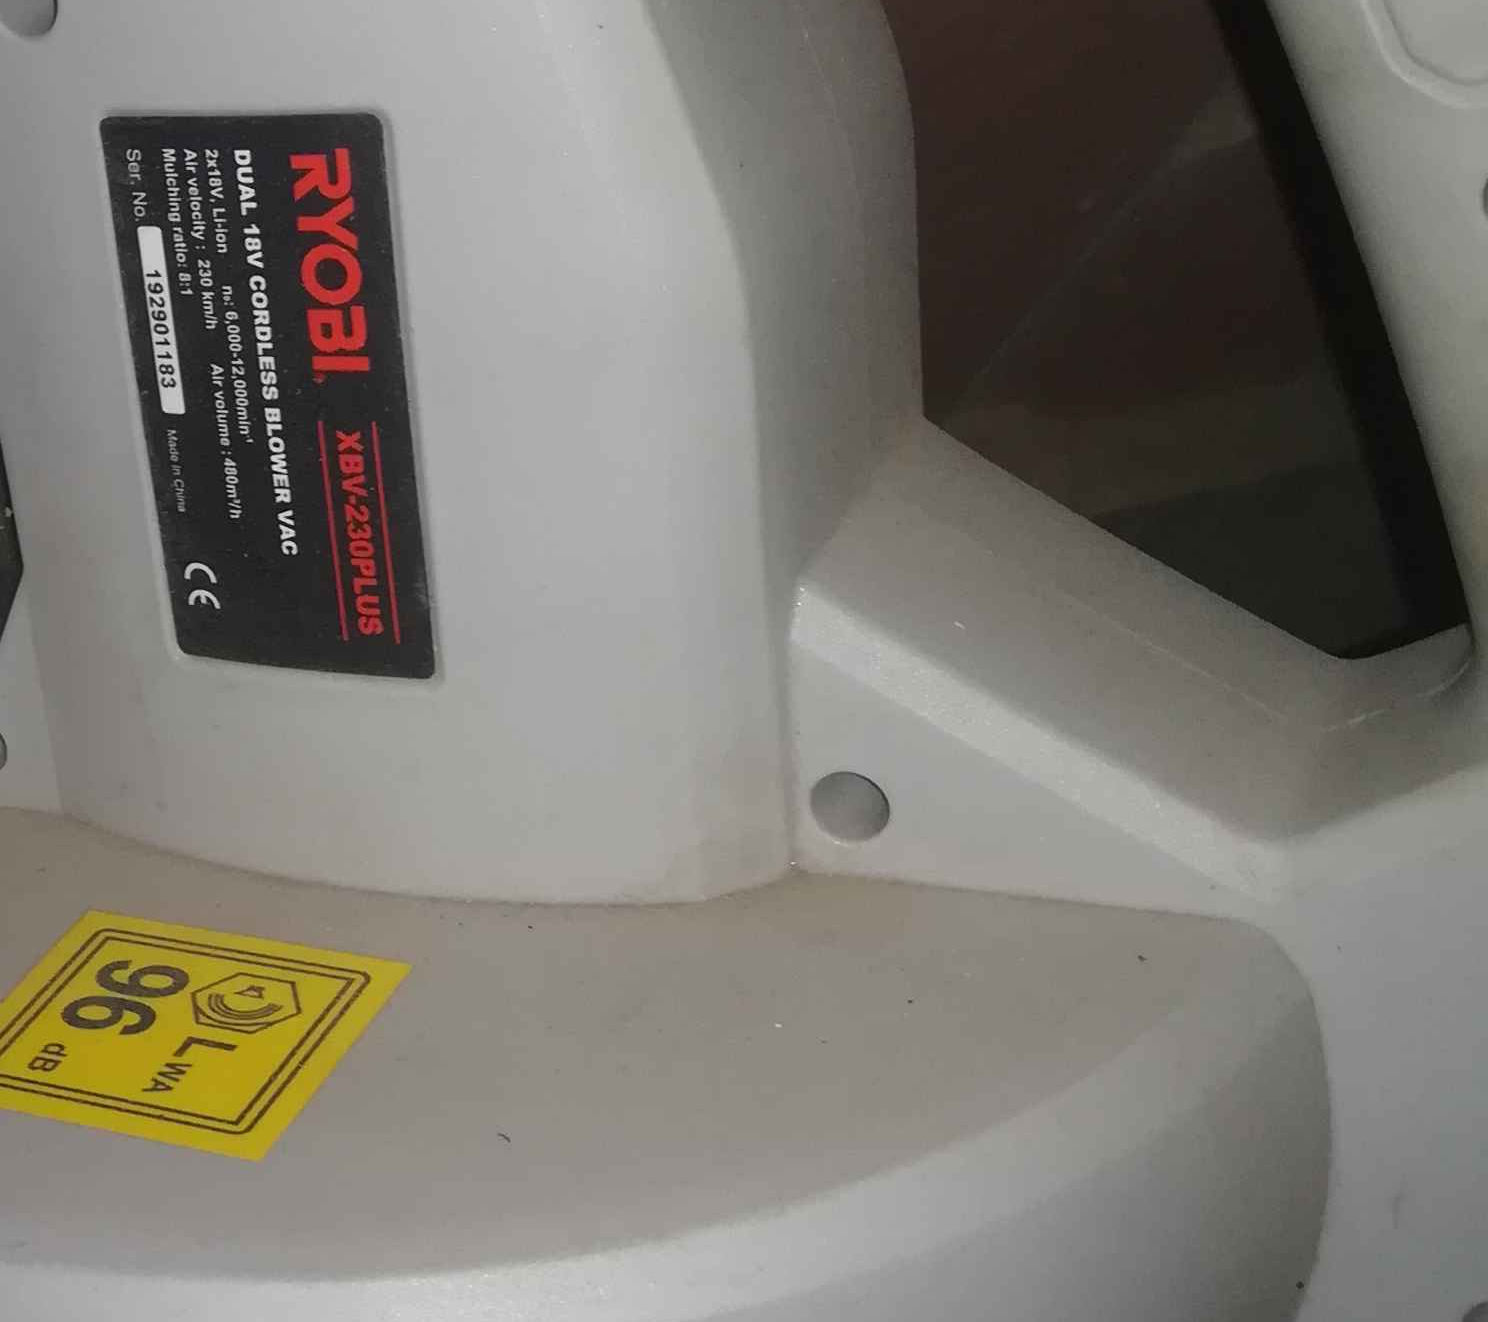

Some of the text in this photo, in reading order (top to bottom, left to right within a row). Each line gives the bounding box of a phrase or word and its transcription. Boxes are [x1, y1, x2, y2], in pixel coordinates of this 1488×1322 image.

[184, 149, 198, 173] Air
[205, 149, 228, 253] 2x18V, Li-ion
[126, 149, 177, 388] Ser. No. 192901183
[161, 149, 193, 295] Mulching ratio: 8:1
[198, 259, 213, 287] 230
[290, 148, 370, 372] RYOBI
[201, 291, 218, 329] km/h
[234, 149, 298, 555] DUAL 18V CORDLESS BLOWER VAC
[210, 364, 224, 386] Air
[214, 391, 231, 446] volume
[166, 429, 187, 513] Made in China
[336, 430, 384, 635] XBV-230PLUS
[27, 959, 190, 1073] 96 dB
